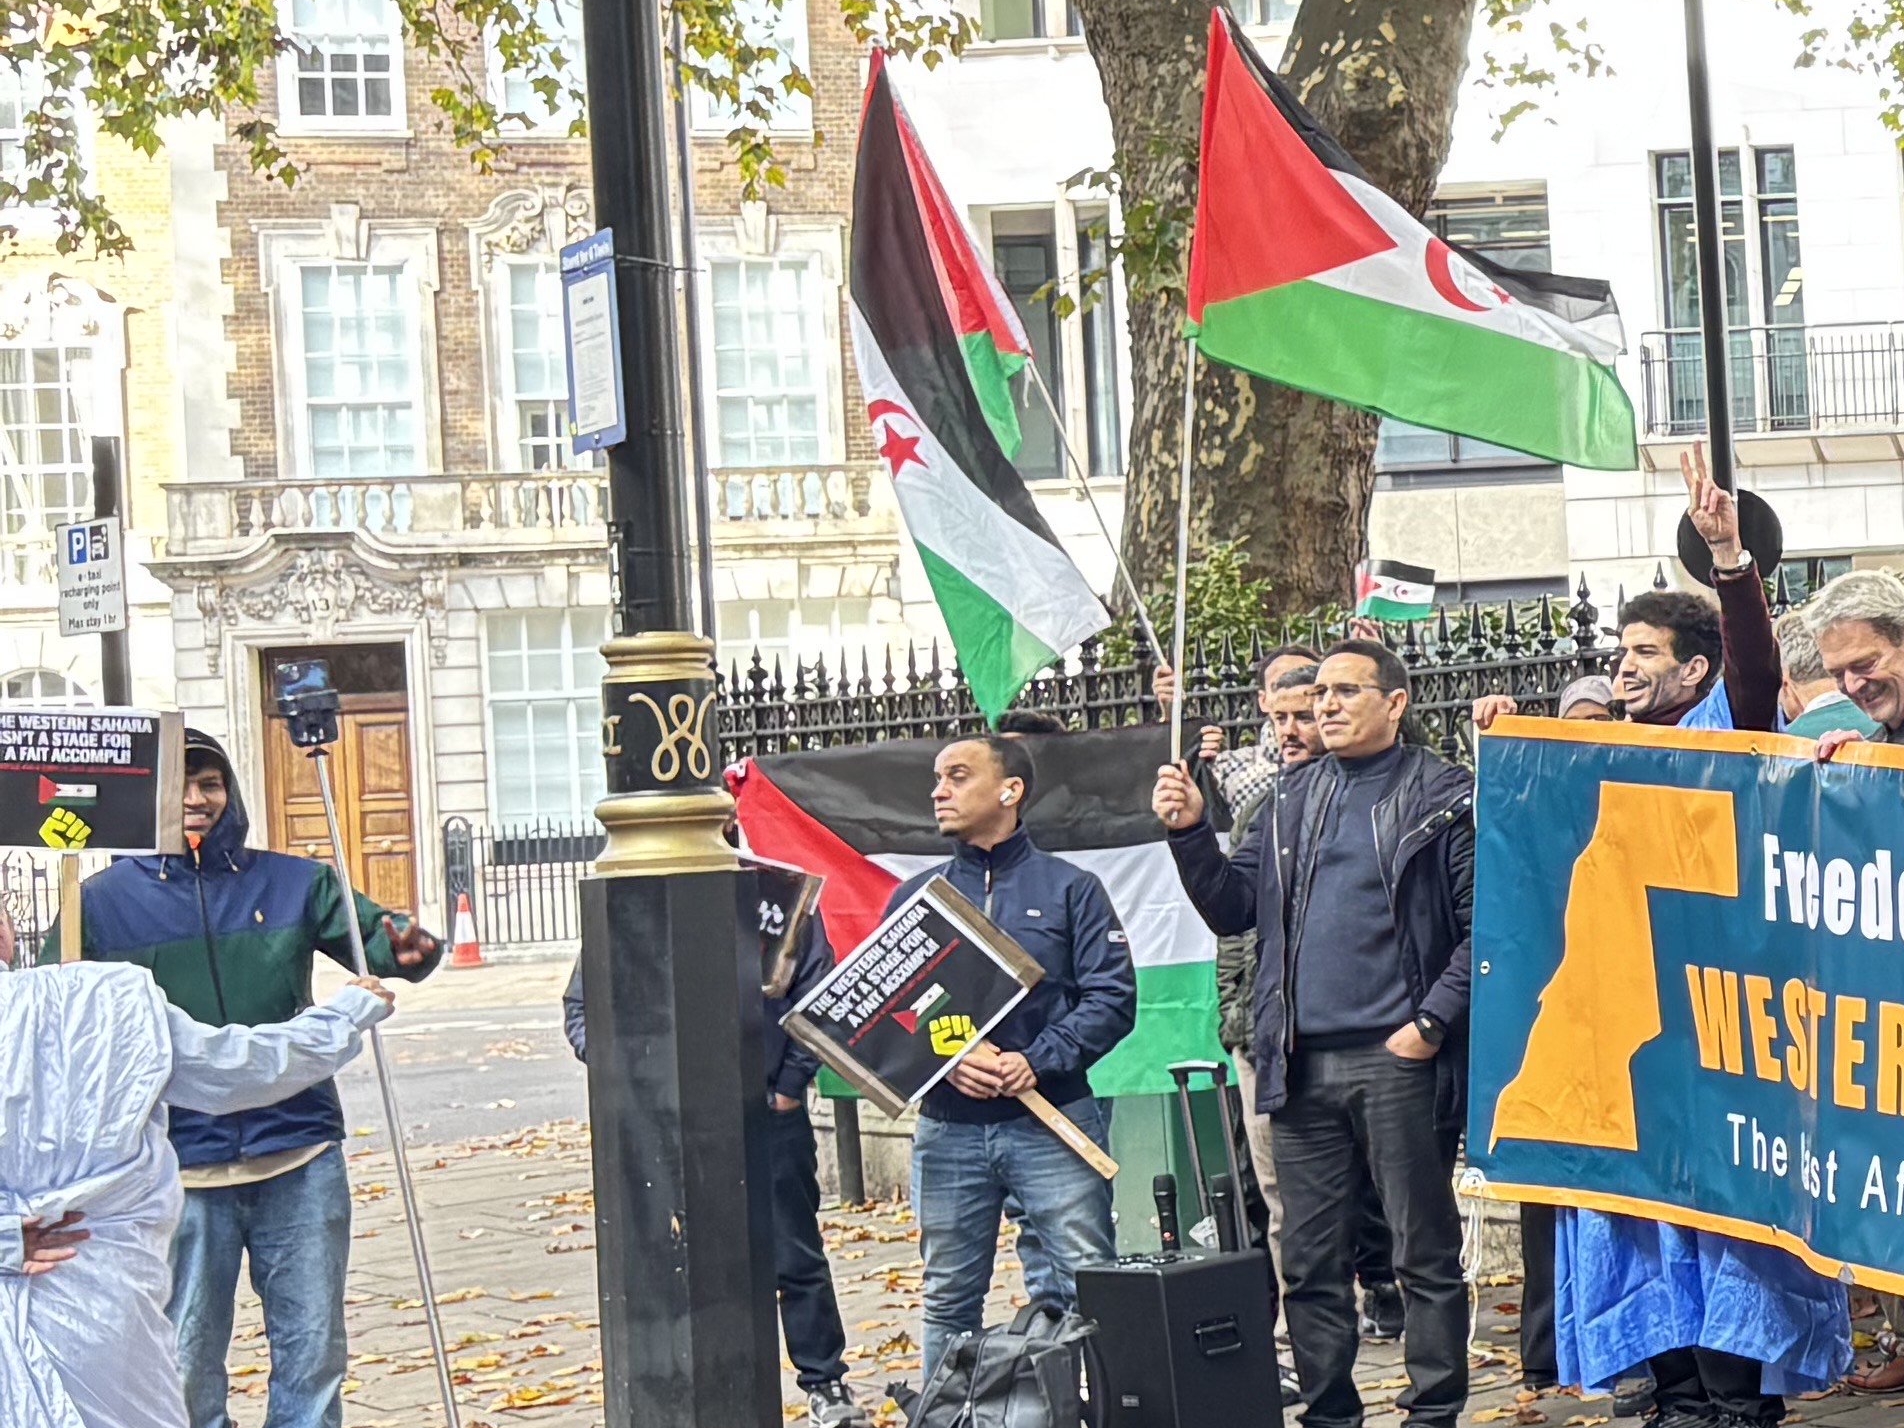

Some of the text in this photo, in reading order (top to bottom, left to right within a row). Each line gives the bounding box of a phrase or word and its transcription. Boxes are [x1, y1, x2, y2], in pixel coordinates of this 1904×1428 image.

[72, 531, 85, 562] P
[61, 581, 121, 598] recharging point
[83, 599, 99, 610] only
[68, 617, 84, 629] Max
[86, 616, 101, 628] stay
[0, 715, 153, 733] HE WESTERN SAHARA
[38, 731, 49, 746] A
[52, 732, 98, 747] STAGE
[101, 733, 132, 749] FOR
[4, 746, 17, 760] A
[19, 746, 49, 761] FAIT
[807, 903, 931, 1018] THE WESTERN SAHARA
[828, 925, 928, 1023] ISN'T A STAGE FOR
[846, 1012, 863, 1029] A
[855, 987, 886, 1022] FAIT
[1727, 1113, 1790, 1175] The
